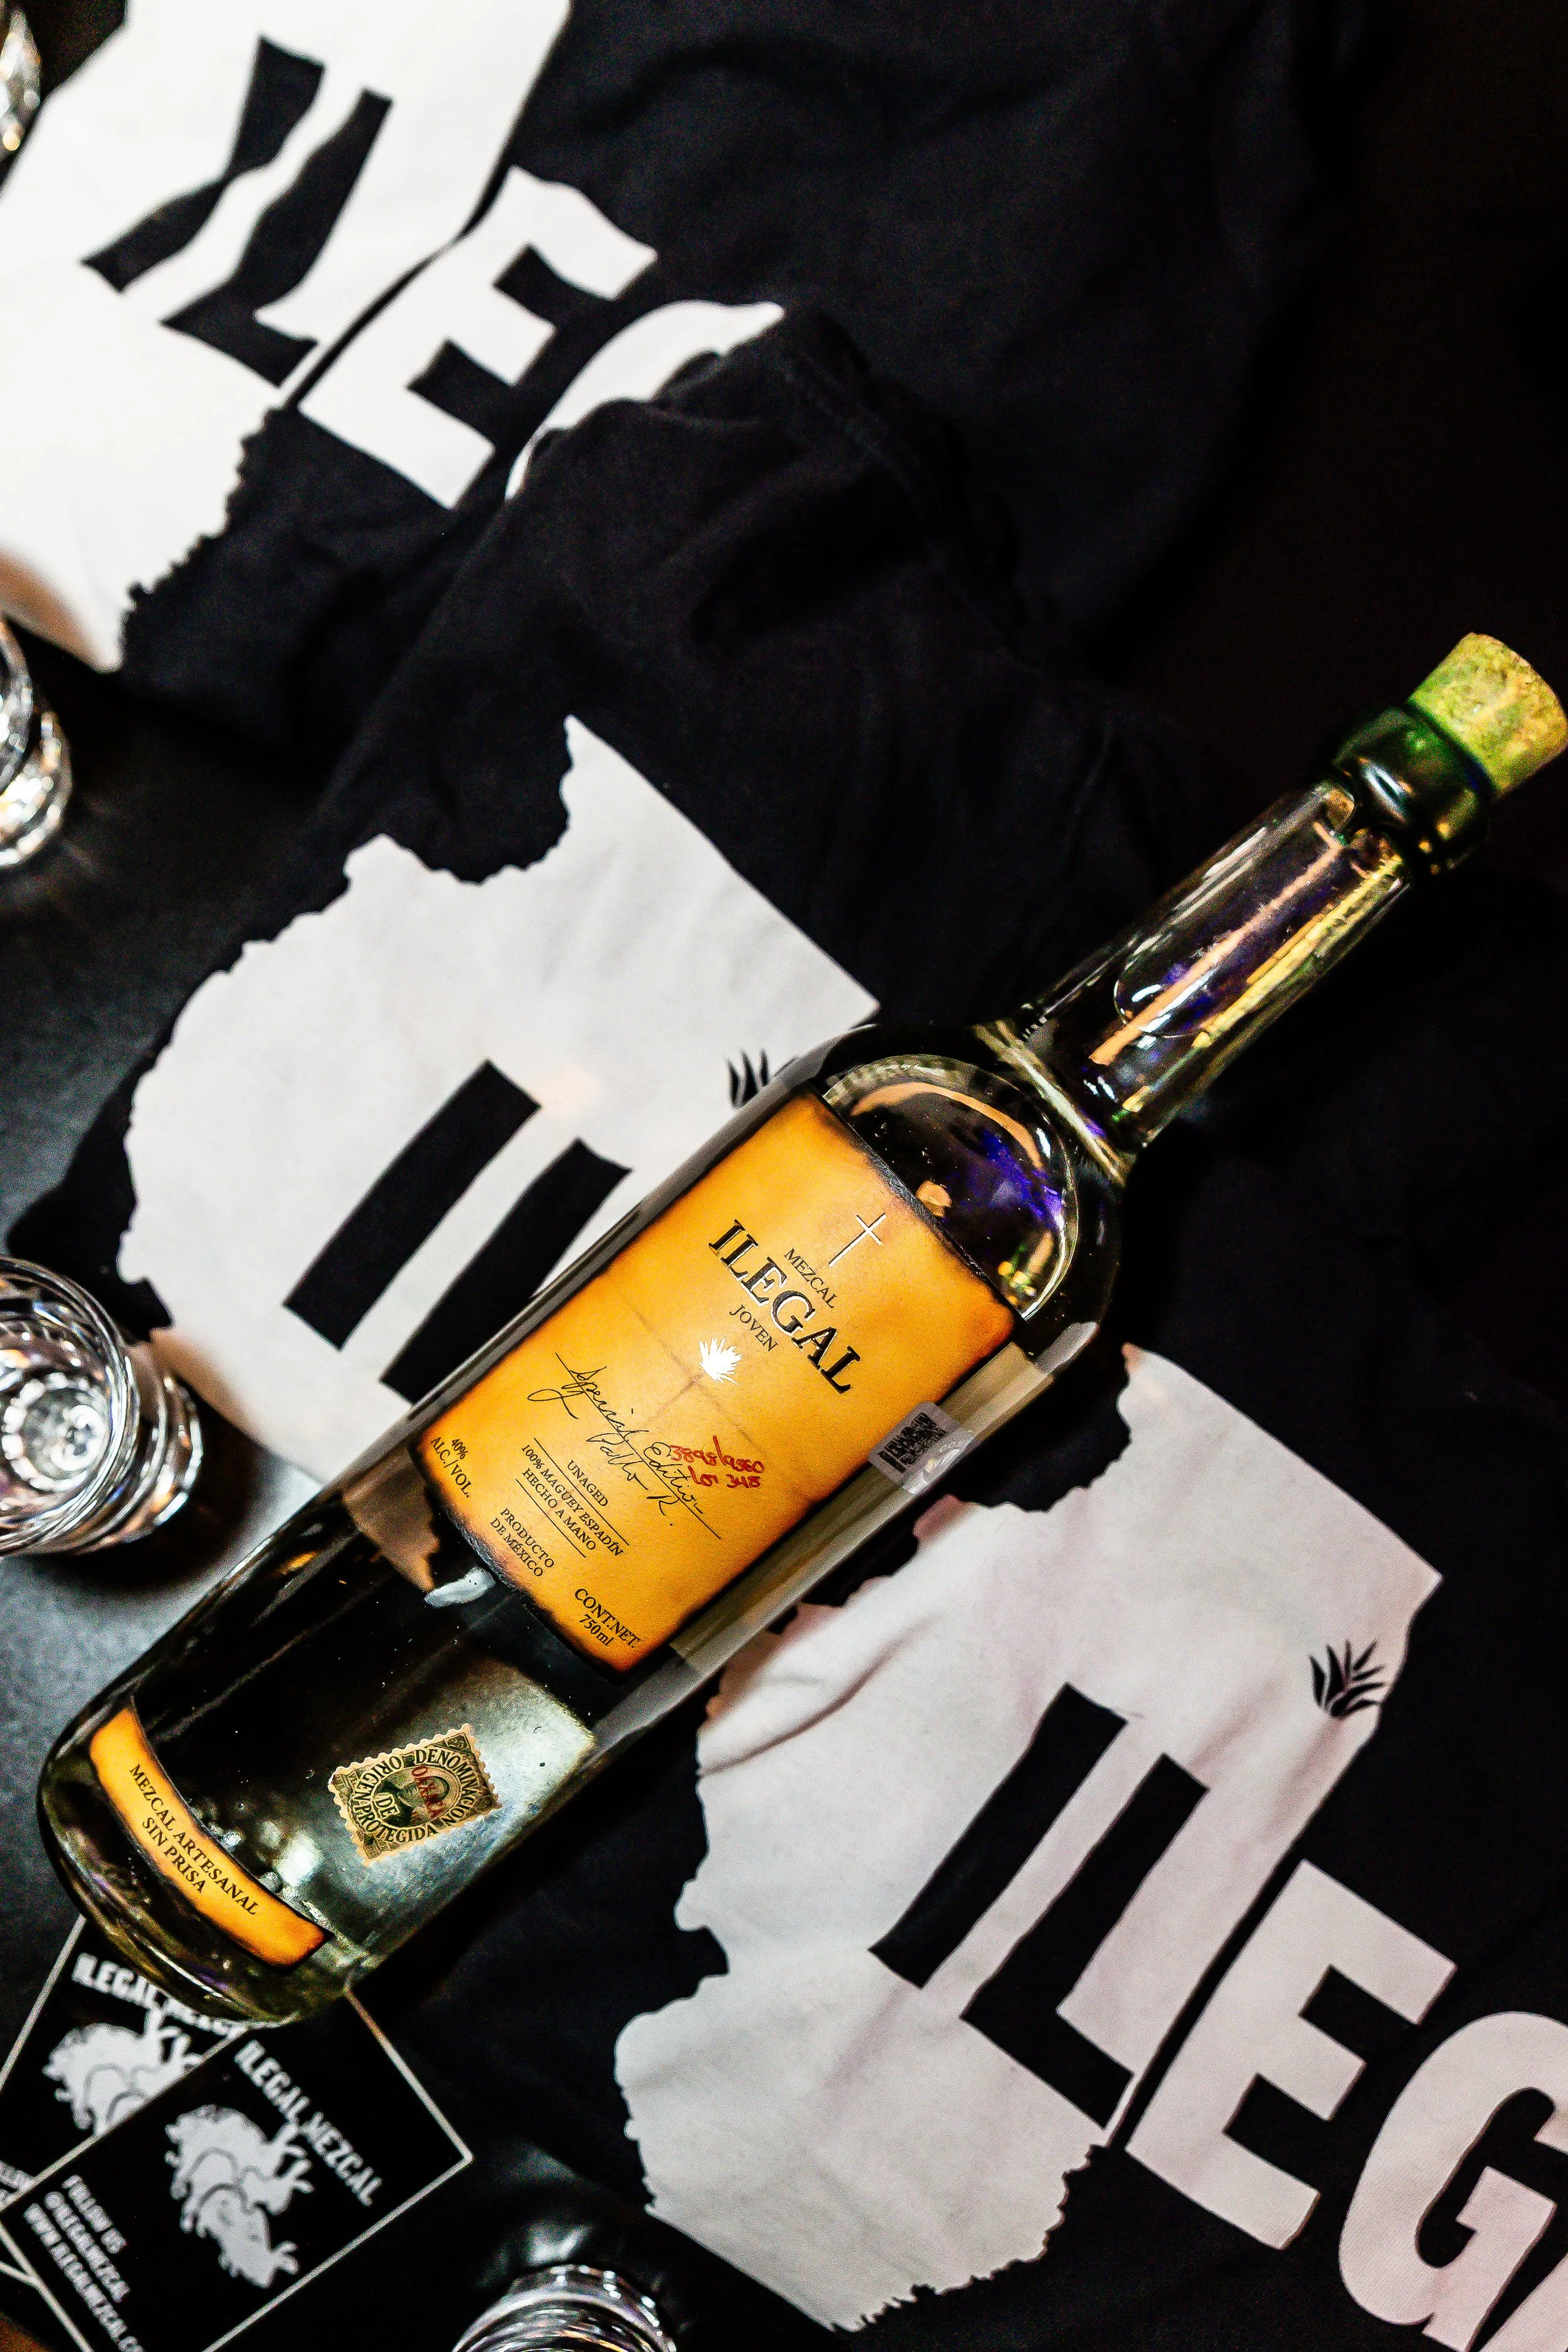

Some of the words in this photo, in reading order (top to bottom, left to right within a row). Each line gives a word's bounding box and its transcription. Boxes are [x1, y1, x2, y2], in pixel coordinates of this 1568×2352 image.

[708, 1219, 861, 1394] ILEGAL
[784, 1248, 839, 1309] MEZCAL
[729, 1305, 779, 1352] JOVEN
[451, 1438, 469, 1459] 40%
[521, 1444, 544, 1470] 100%
[540, 1468, 584, 1513] MAGUEY
[578, 1511, 624, 1556] ESPADÍN
[522, 1468, 558, 1508] HECHO
[555, 1508, 565, 1518] A
[563, 1515, 596, 1550] MANO
[567, 1459, 608, 1507] UNAGED
[490, 1517, 507, 1536] DE
[504, 1533, 543, 1577] MÉXICO
[500, 1507, 554, 1568] PRODUCTO
[353, 1755, 403, 1805] ORIGEN
[377, 1796, 400, 1820] DE
[415, 1749, 476, 1828] DENOMINACION
[129, 1764, 174, 1831] MEZCAL
[173, 1831, 261, 1915] ARTESANAL
[354, 1803, 438, 1843] PROTEGIDA
[142, 1816, 169, 1847] SIN
[163, 1845, 206, 1894] PRISA
[233, 2039, 311, 2125] ILEGAL
[302, 2111, 383, 2207] MEZCAL
